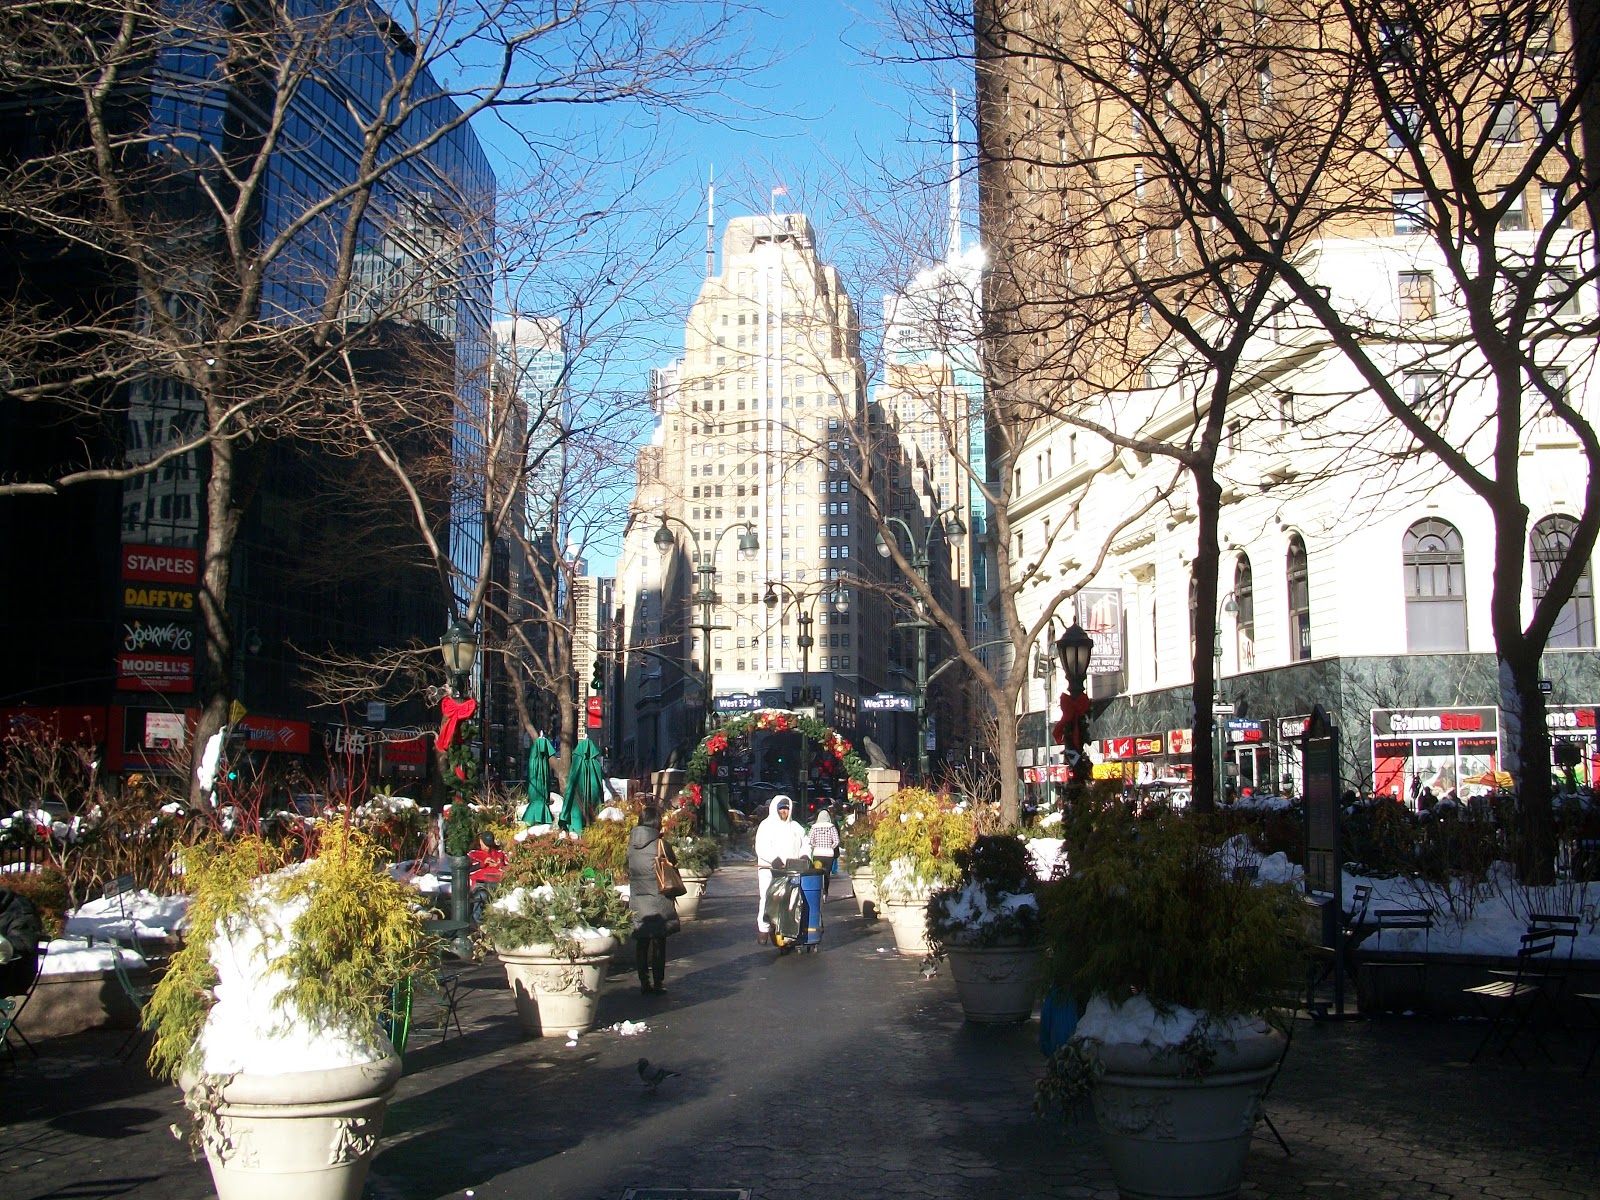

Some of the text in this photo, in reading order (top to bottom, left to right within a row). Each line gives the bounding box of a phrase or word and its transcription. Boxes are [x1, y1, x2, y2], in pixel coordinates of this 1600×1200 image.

[127, 554, 194, 574] STAPLES
[124, 586, 193, 609] DAFFY'S
[123, 621, 192, 651] JOURNEYS
[122, 659, 190, 673] MODELL'S
[719, 698, 761, 708] West 33rd St
[863, 698, 909, 708] West 33rd St
[1390, 711, 1482, 731] GameStop
[1458, 739, 1496, 747] players
